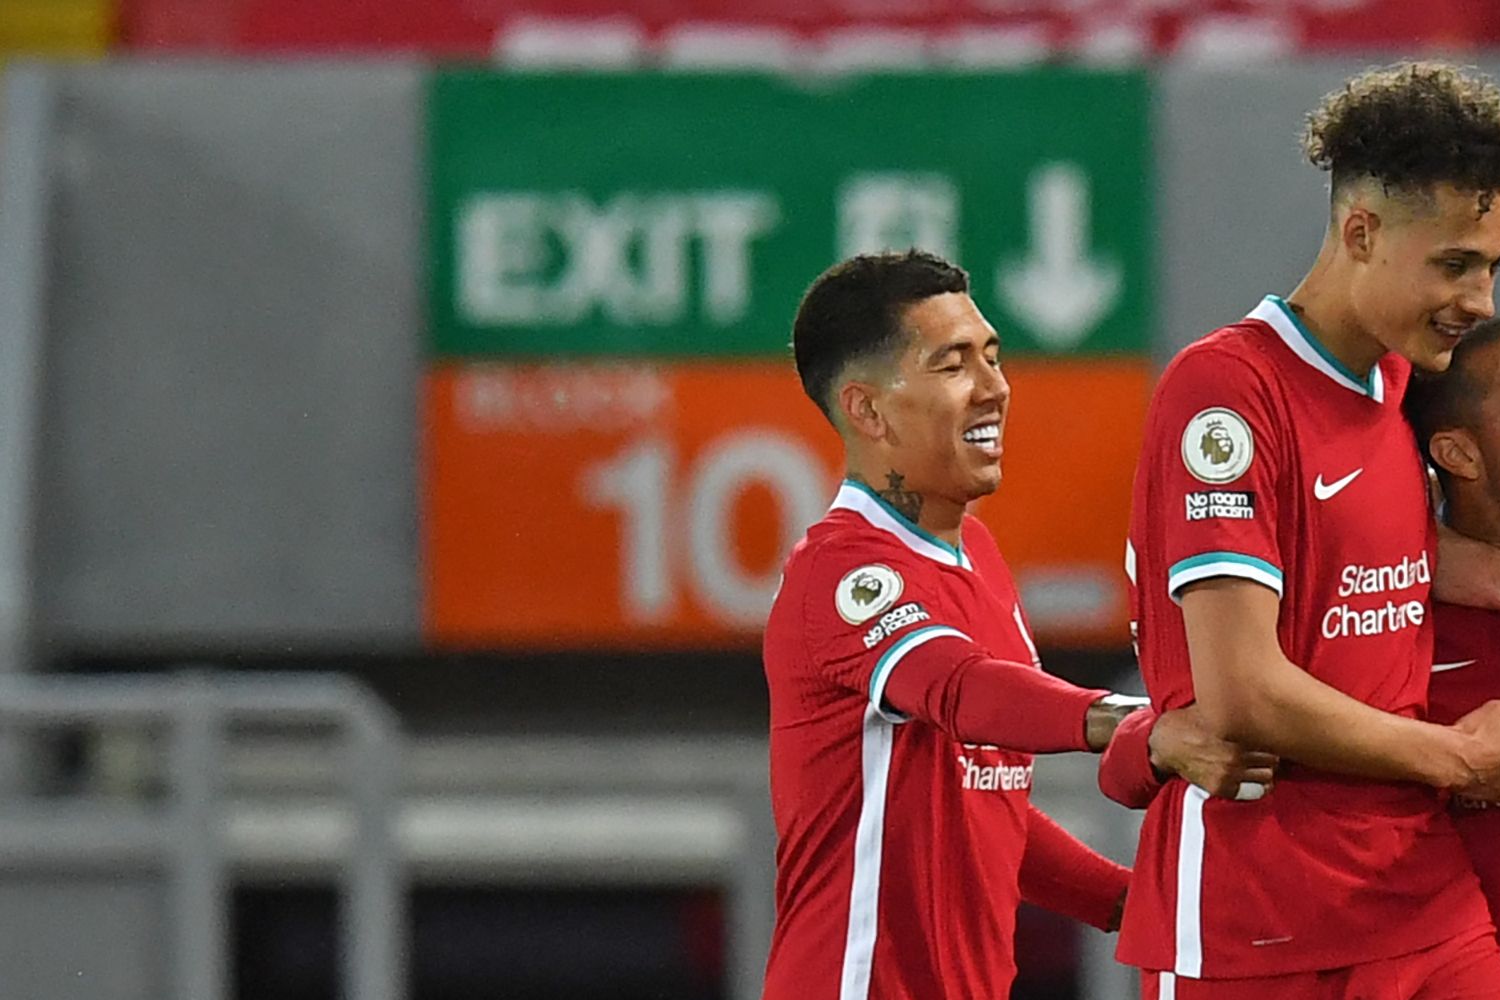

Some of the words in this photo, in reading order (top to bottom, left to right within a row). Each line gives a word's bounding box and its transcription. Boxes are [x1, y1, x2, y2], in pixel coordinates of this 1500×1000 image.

[454, 190, 782, 326] EXIT
[1185, 492, 1208, 507] No
[1209, 492, 1248, 506] room
[880, 603, 920, 628] room
[1322, 600, 1424, 639] Chartere
